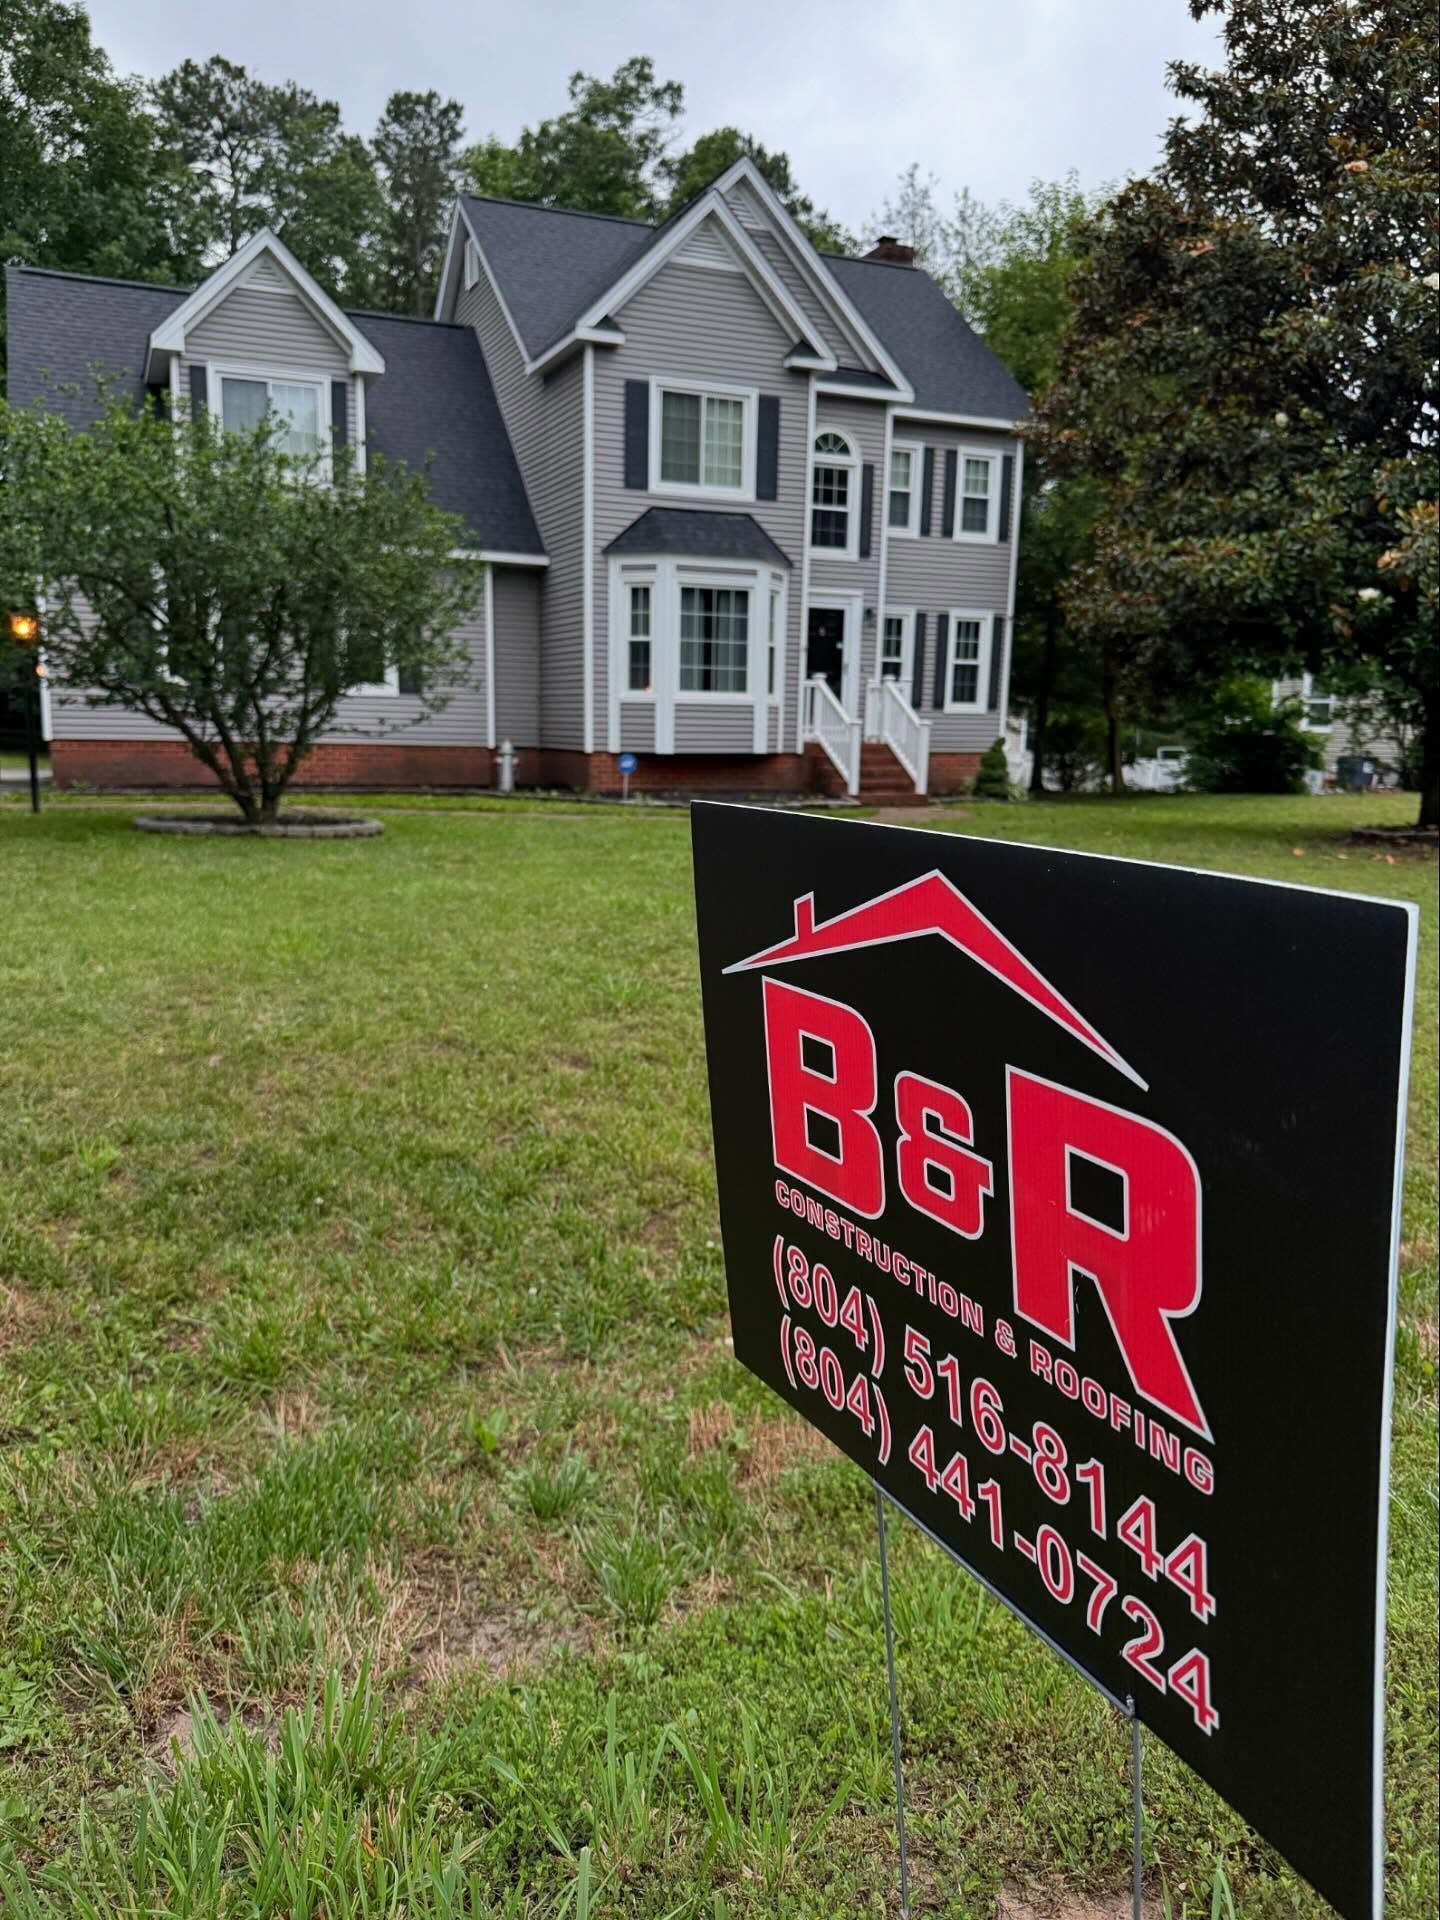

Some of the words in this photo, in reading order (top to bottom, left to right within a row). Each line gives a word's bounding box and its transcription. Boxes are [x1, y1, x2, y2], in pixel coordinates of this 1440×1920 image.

[762, 976, 1215, 1443] B&R
[776, 1180, 984, 1336] CONSTRUCTION
[995, 1318, 1018, 1358] &
[1030, 1339, 1215, 1494] ROOFING
[773, 1235, 885, 1379] (804)
[904, 1324, 1216, 1624] 516-8144
[780, 1315, 891, 1465] (804)
[908, 1425, 1219, 1736] 441-0724
